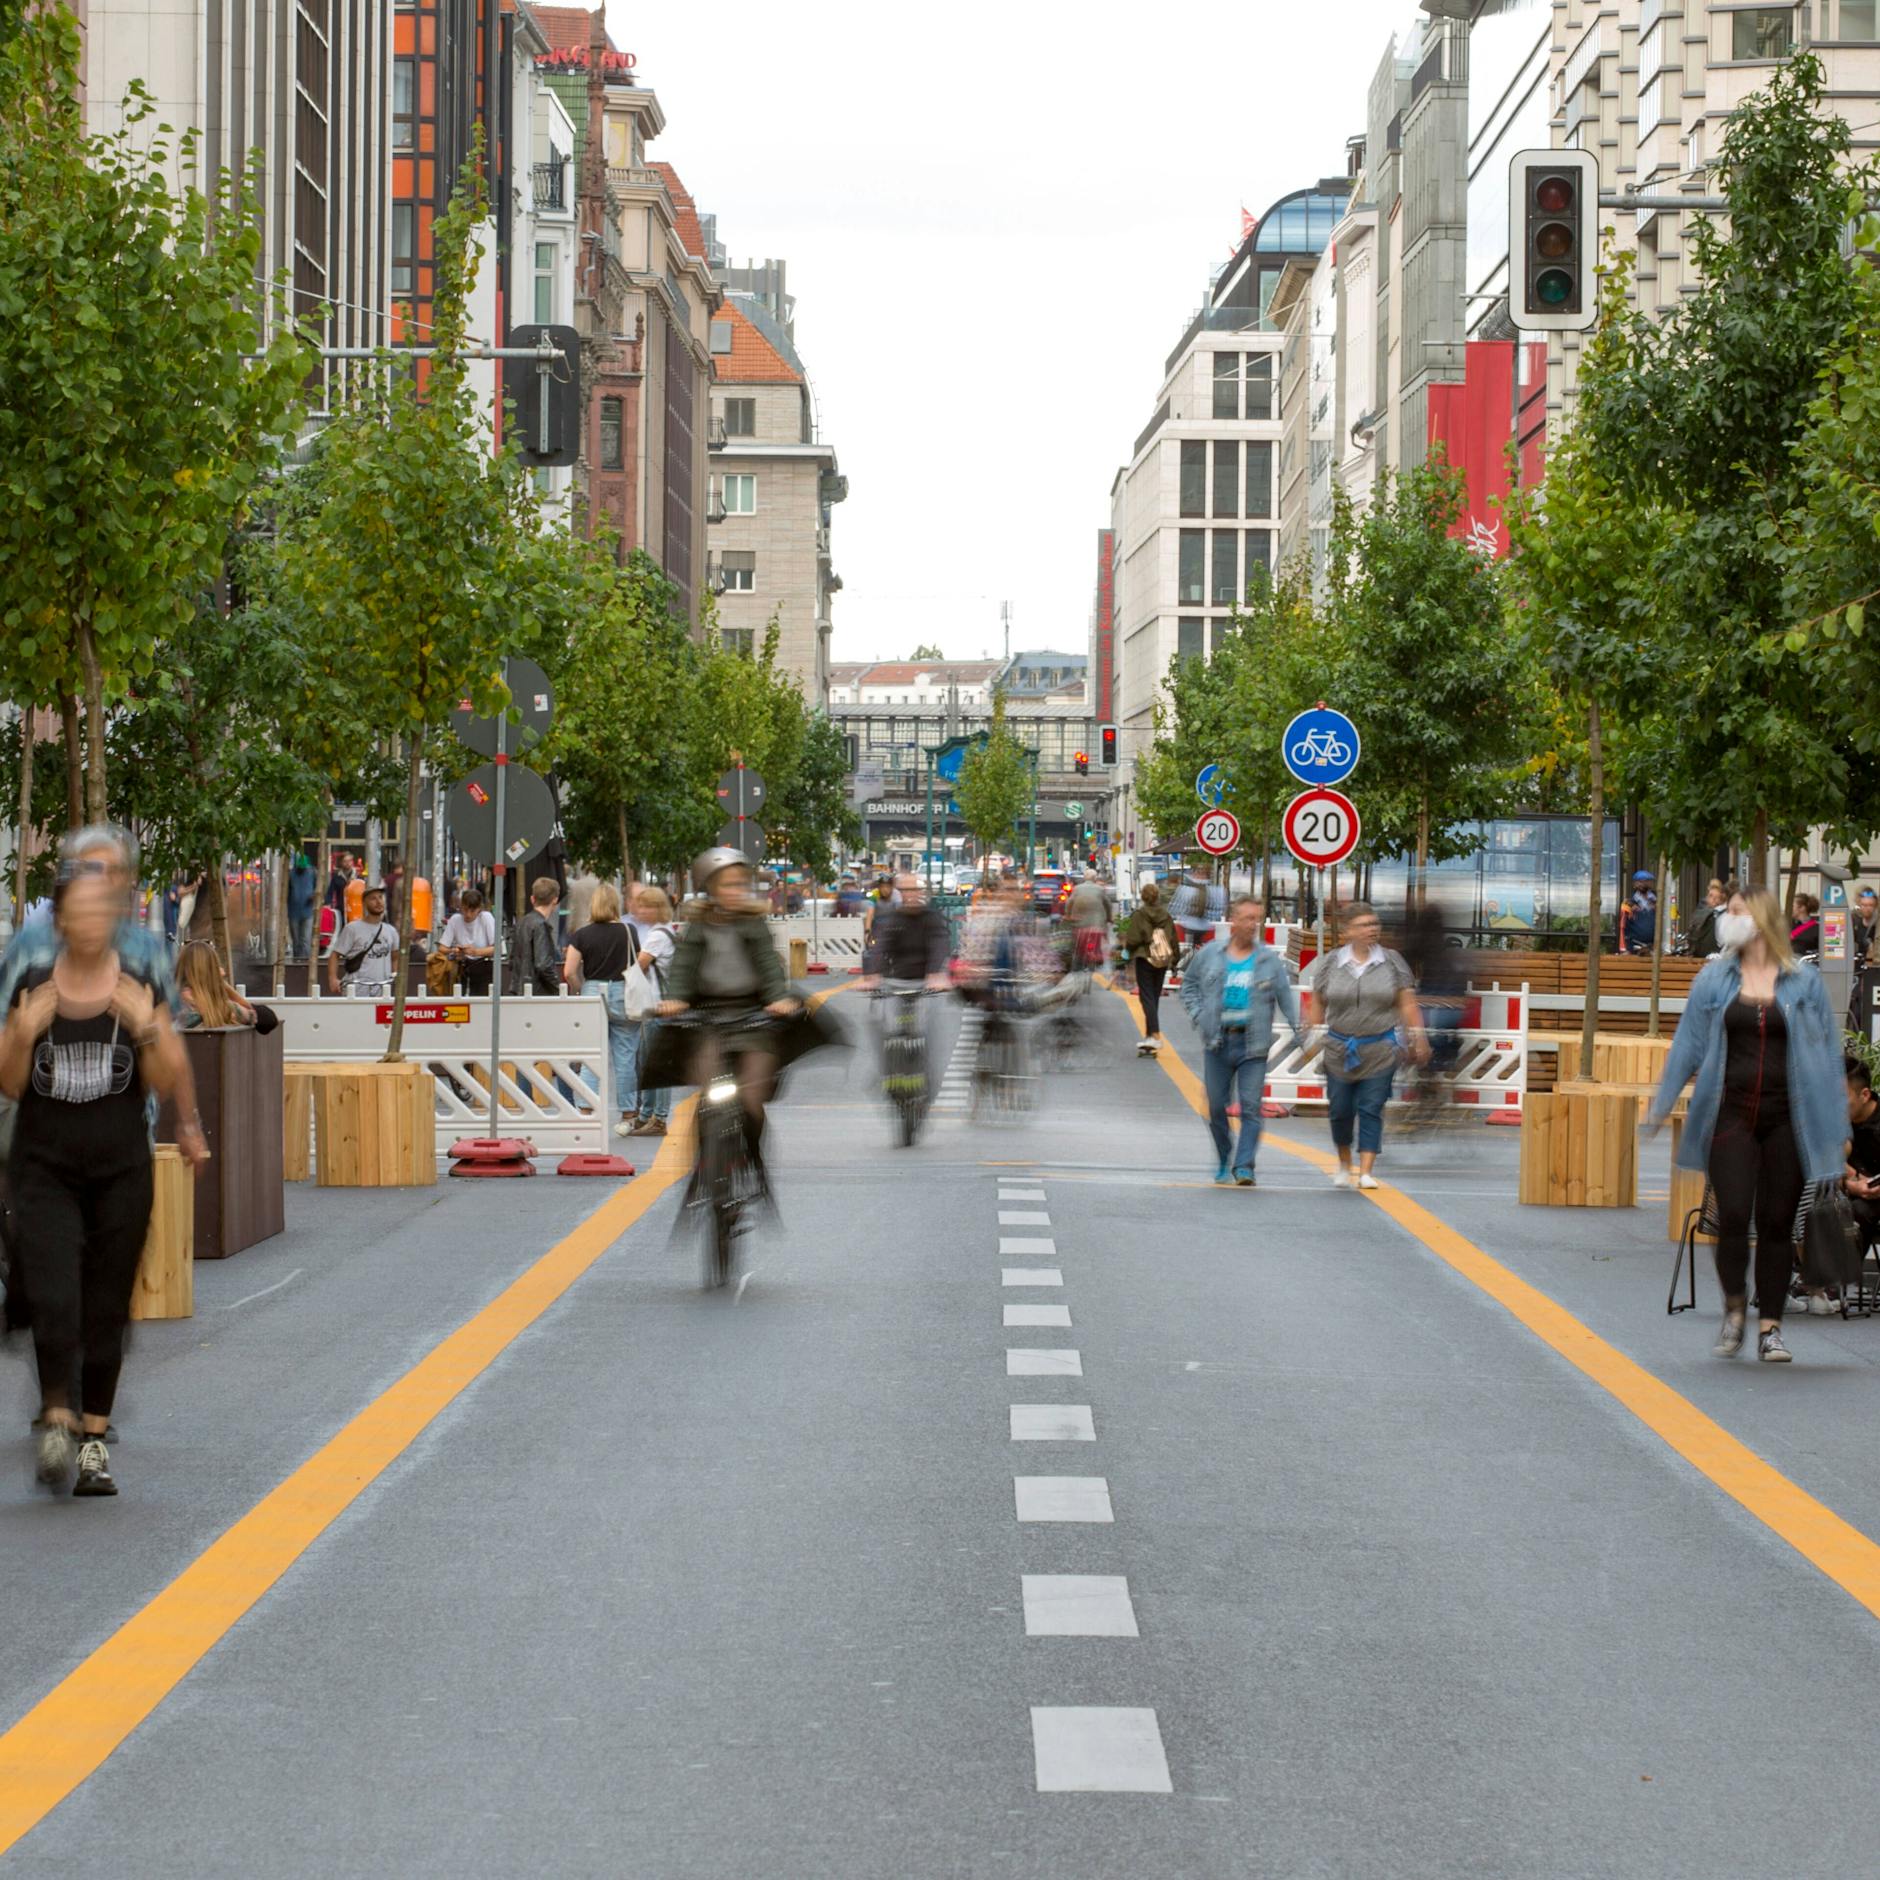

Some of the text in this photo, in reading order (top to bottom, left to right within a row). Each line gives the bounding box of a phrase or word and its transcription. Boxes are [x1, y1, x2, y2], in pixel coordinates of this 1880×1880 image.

[868, 803, 924, 814] BAHNHOF
[1206, 823, 1229, 840] 20
[1302, 812, 1341, 842] 20
[1830, 885, 1843, 904] P
[386, 1010, 436, 1019] ZPELIN
